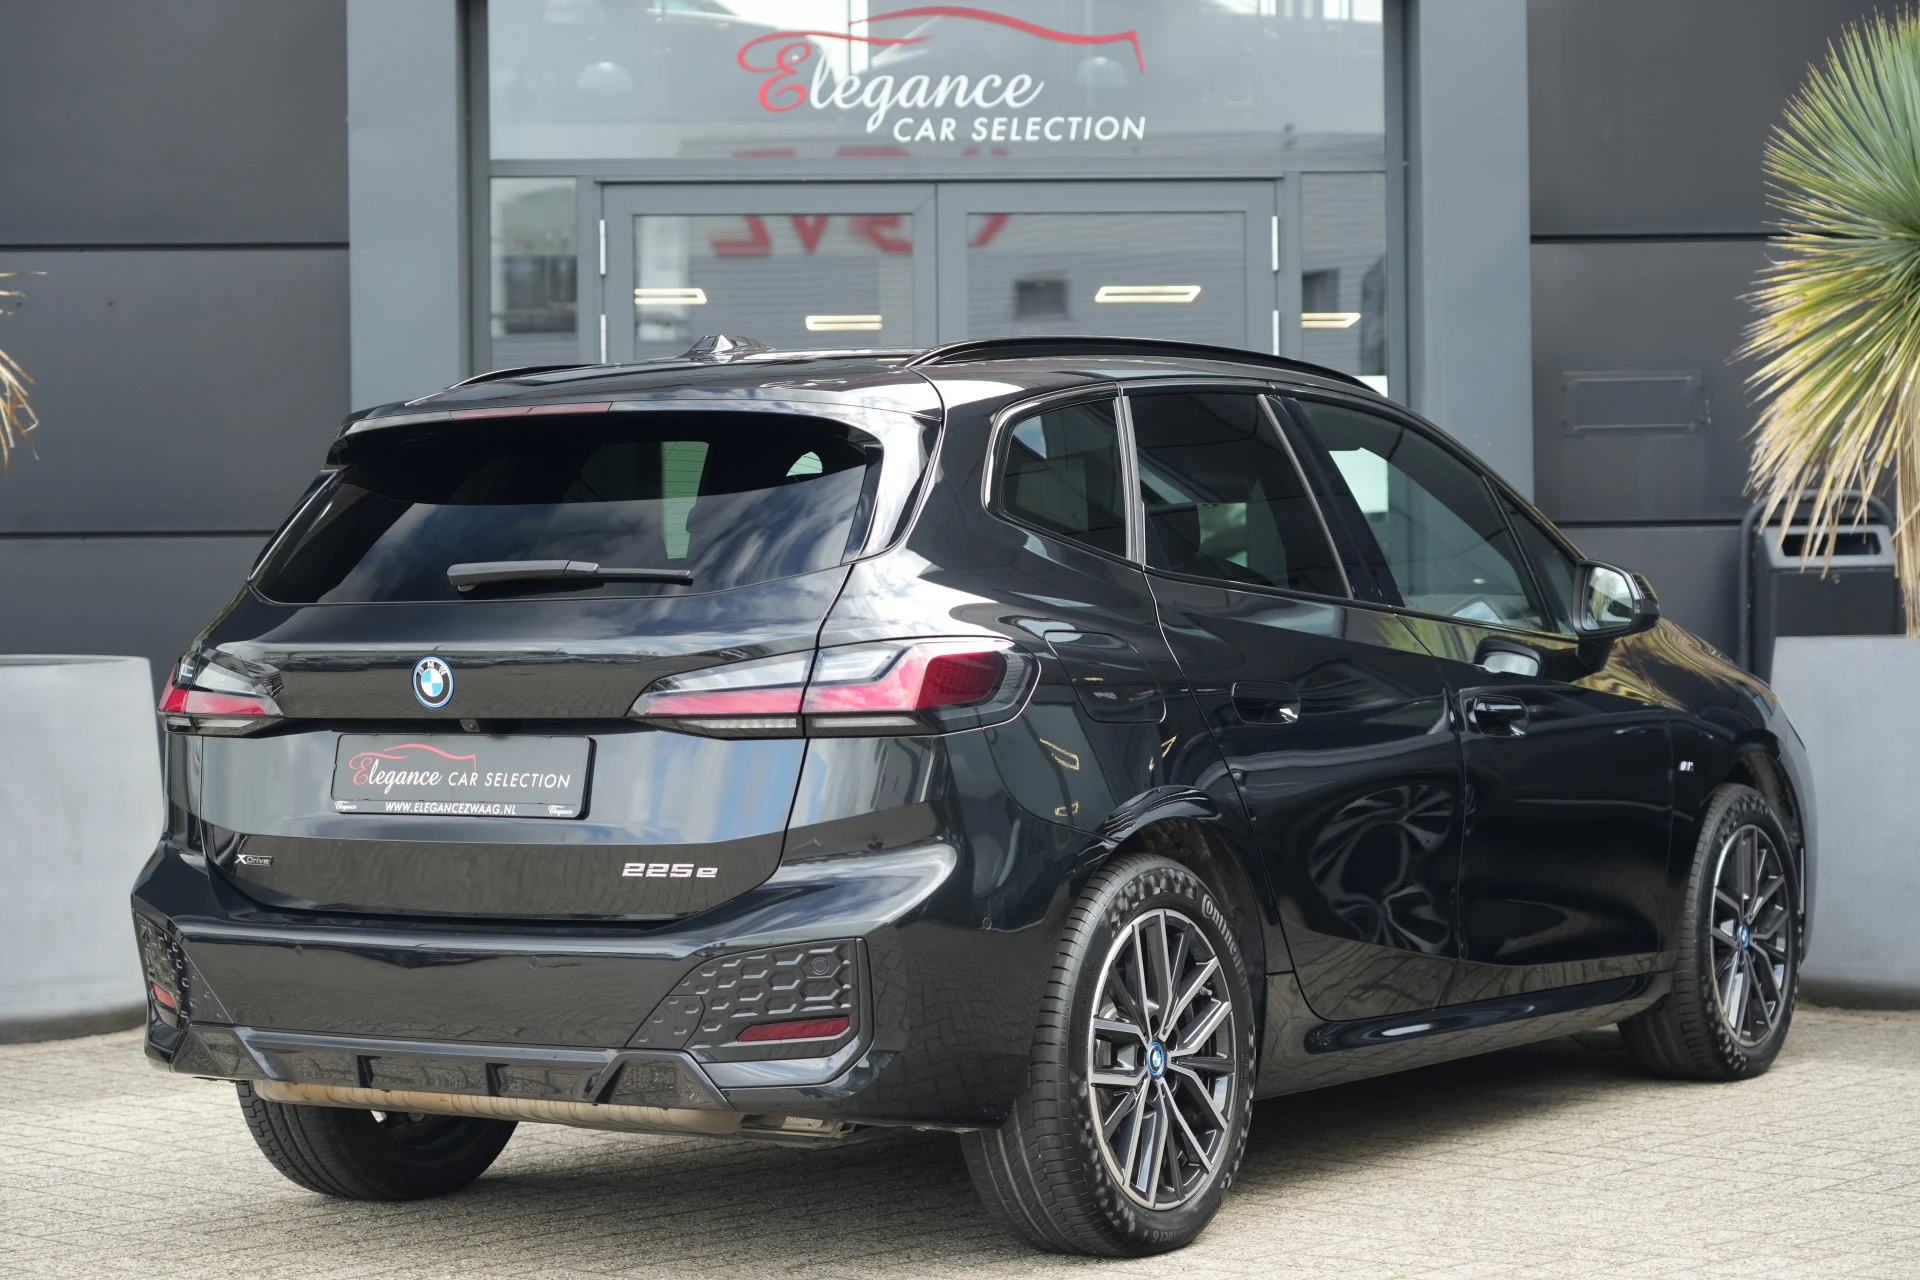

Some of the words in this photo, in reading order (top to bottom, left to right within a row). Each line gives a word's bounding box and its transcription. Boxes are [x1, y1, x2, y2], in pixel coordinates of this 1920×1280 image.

[738, 31, 1044, 134] Elegance
[892, 117, 956, 142] CAR
[971, 116, 1146, 141] SELECTION
[349, 752, 443, 794] Elegance
[448, 771, 478, 786] CAR
[484, 773, 570, 788] SELECTION
[385, 801, 516, 815] WWW.ELEGANCEZWAAG.NL
